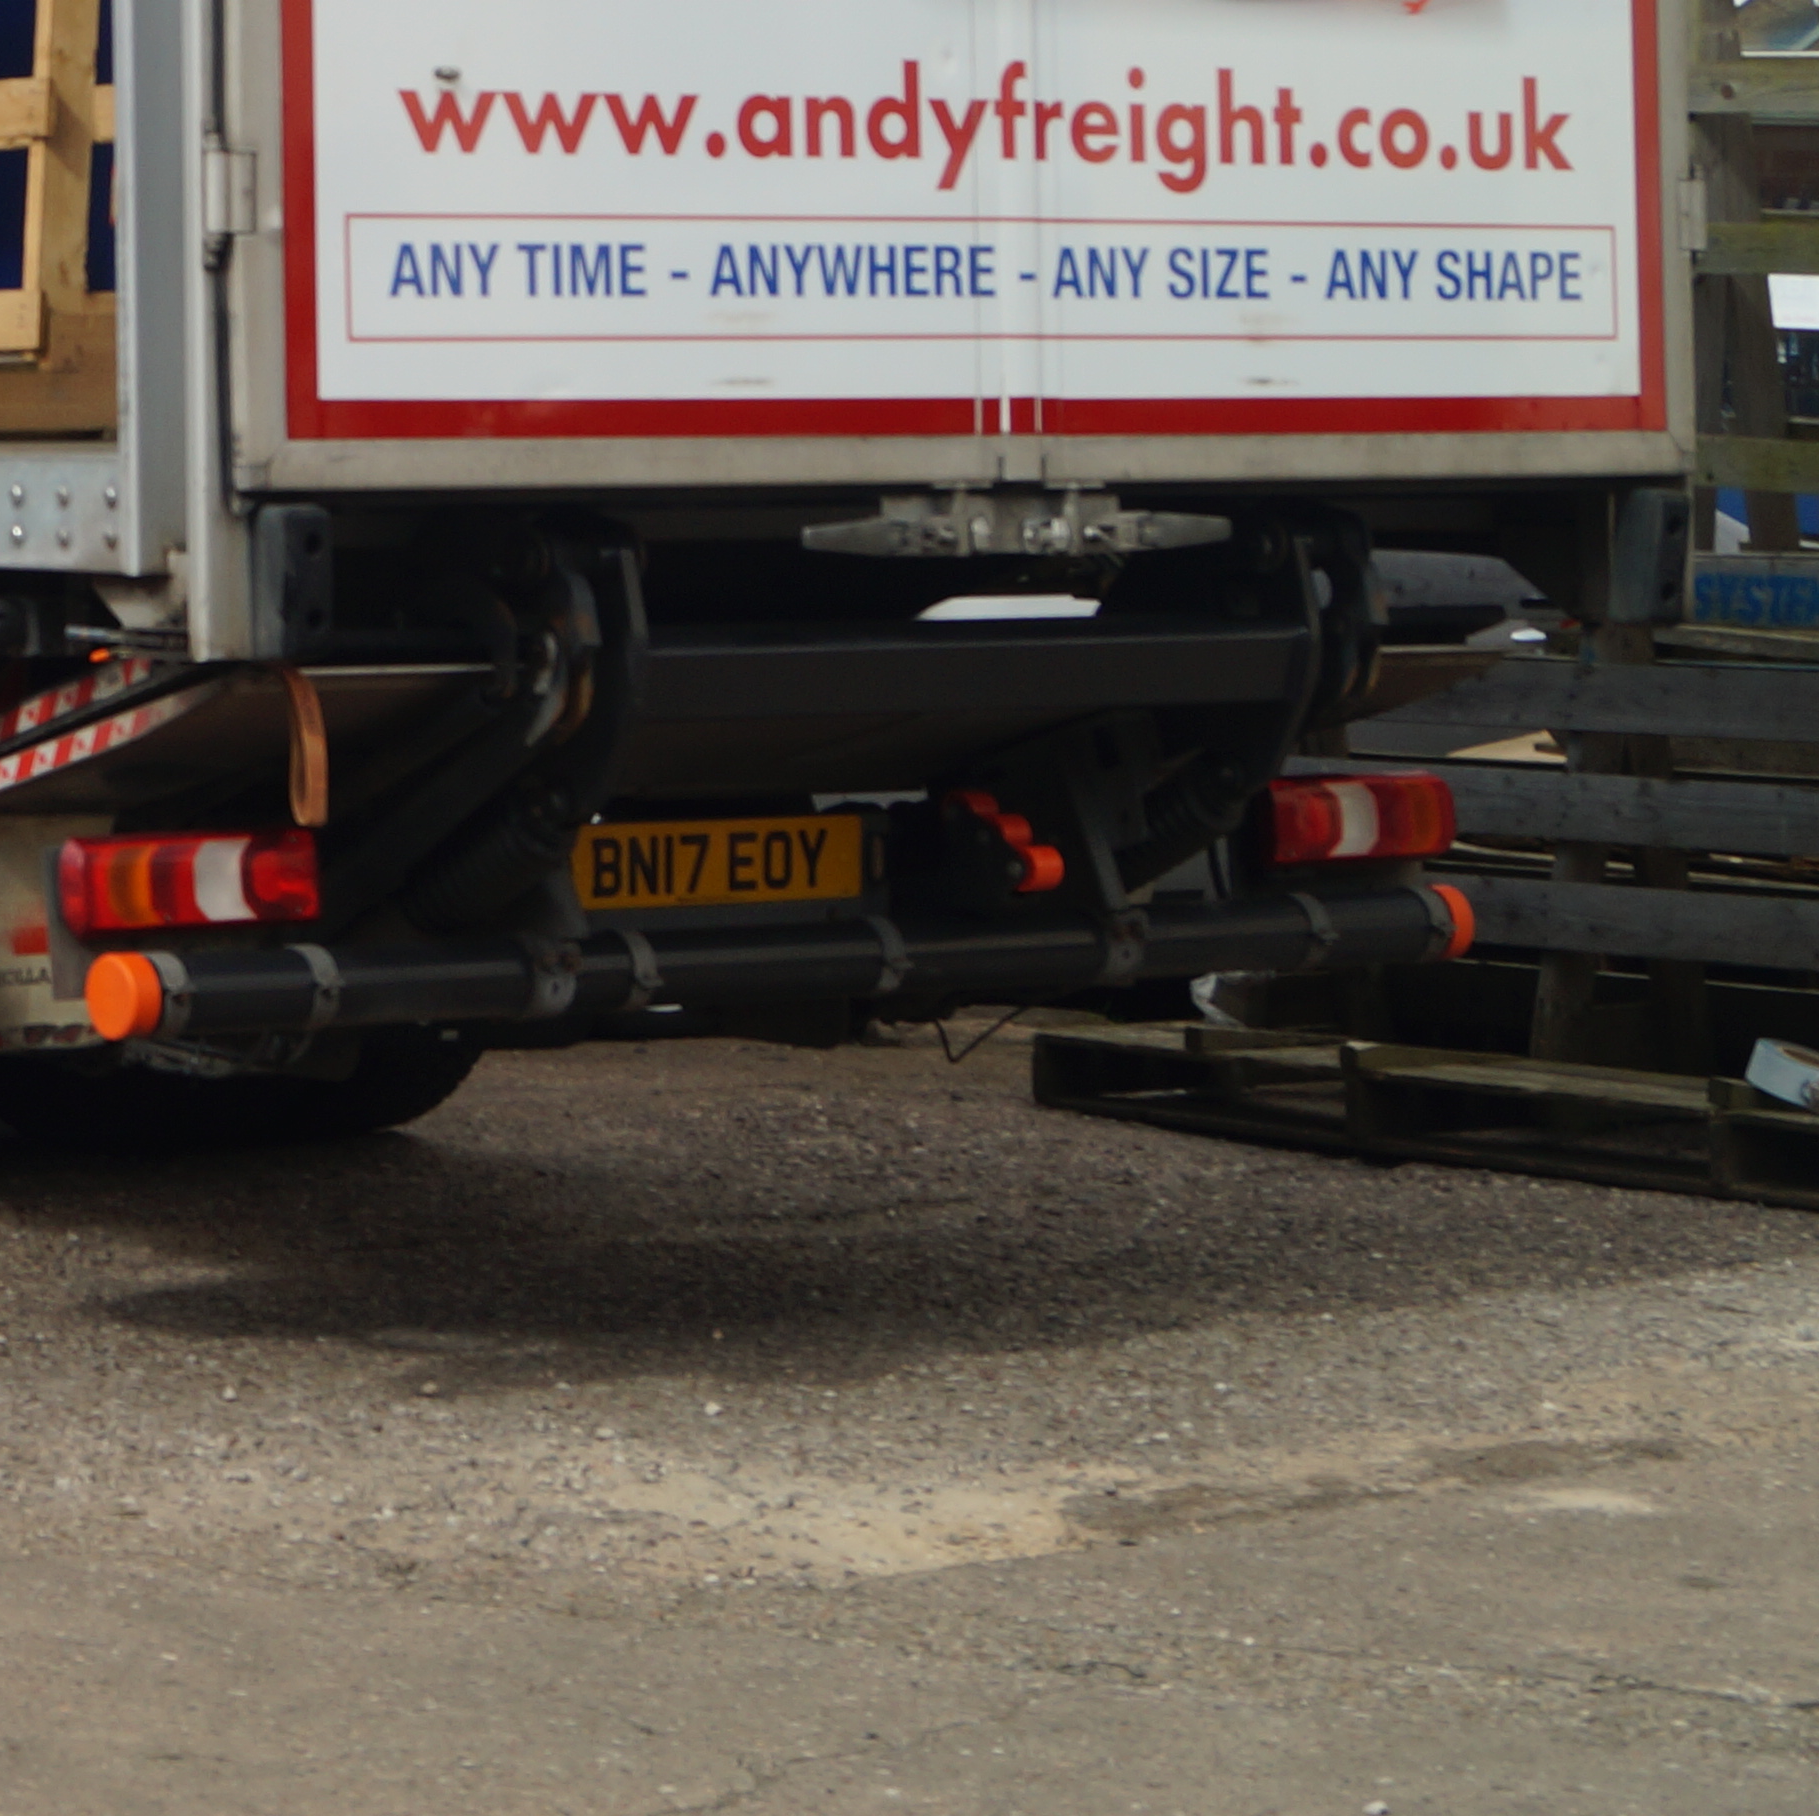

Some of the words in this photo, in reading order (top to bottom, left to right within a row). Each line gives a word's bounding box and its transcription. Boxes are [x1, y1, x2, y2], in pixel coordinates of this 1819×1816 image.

[400, 61, 1575, 194] www.andyfreight.co.uk
[390, 242, 499, 296] ANY
[517, 243, 647, 296] TIME
[709, 243, 996, 297] ANYWHERE
[1053, 245, 1149, 298] ANY
[1168, 247, 1269, 299] SIZE
[1325, 248, 1419, 300] ANY
[1435, 249, 1583, 301] SHAPE
[1694, 572, 1819, 626] SYSTE
[590, 834, 710, 899] BN17
[728, 828, 828, 892] EOY
